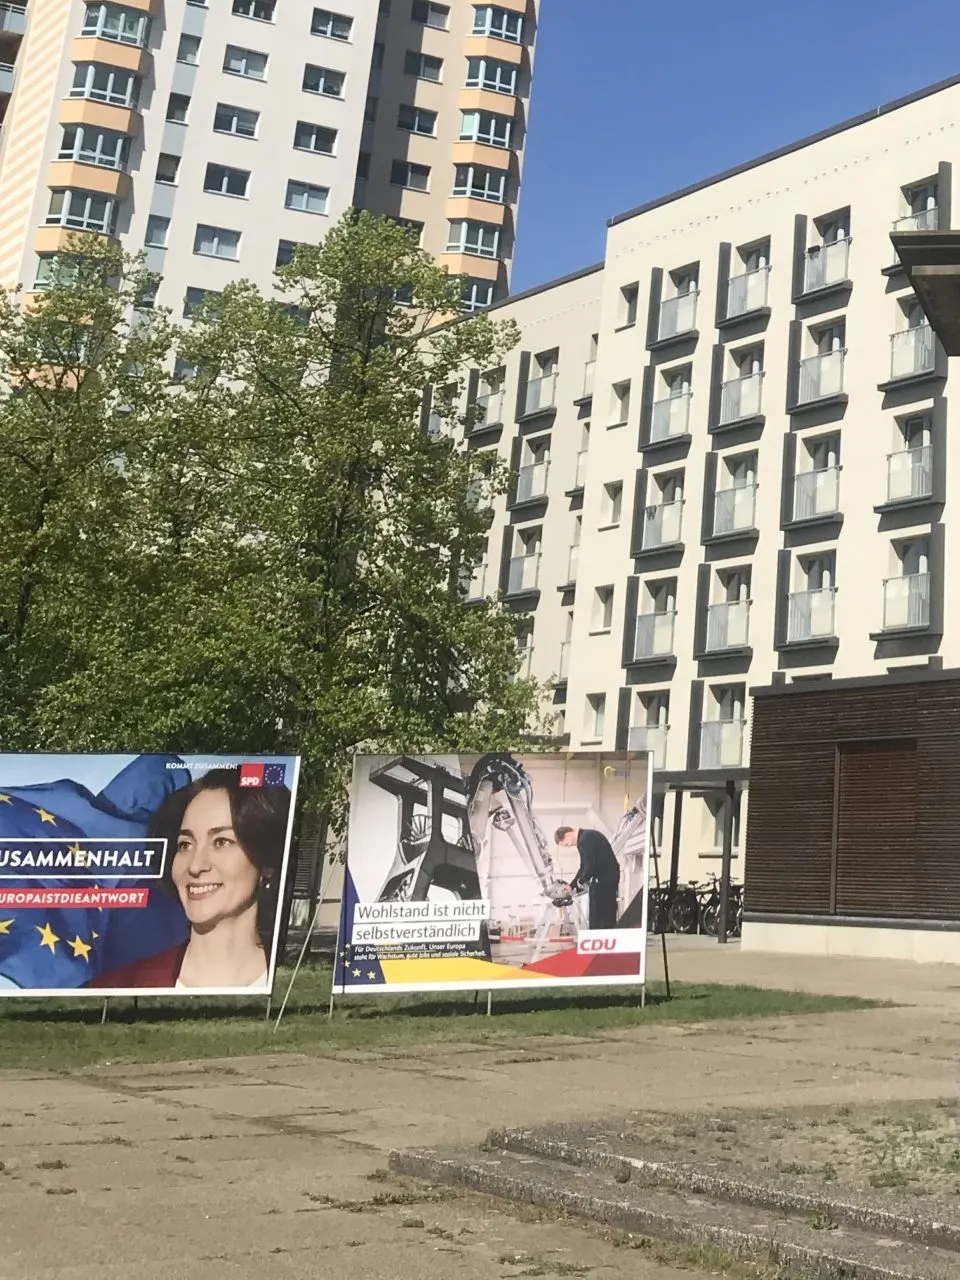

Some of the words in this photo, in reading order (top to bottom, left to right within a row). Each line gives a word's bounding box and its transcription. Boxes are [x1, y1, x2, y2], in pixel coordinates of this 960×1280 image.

[241, 777, 259, 786] SPD
[358, 904, 430, 919] Wohlstand
[433, 904, 449, 916] ist
[453, 903, 486, 916] nicht
[356, 923, 476, 941] selbstverständlich
[580, 938, 617, 951] CDU
